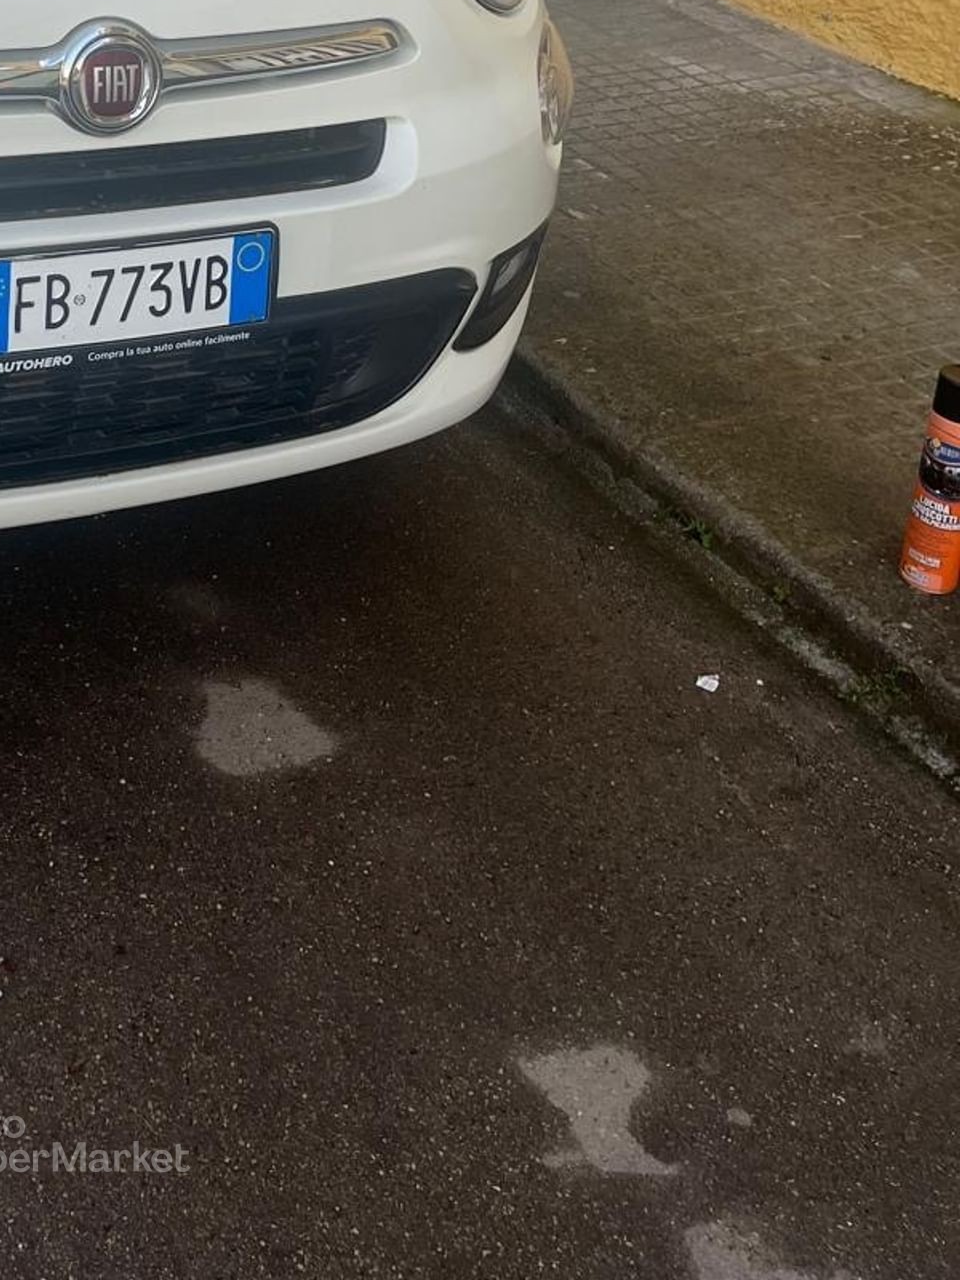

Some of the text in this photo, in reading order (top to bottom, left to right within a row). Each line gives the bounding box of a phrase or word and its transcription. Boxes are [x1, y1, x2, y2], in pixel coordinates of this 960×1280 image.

[93, 64, 139, 103] FIAT
[14, 255, 229, 333] FB 773VB
[88, 331, 250, 361] Compra la tua auto online facilmente
